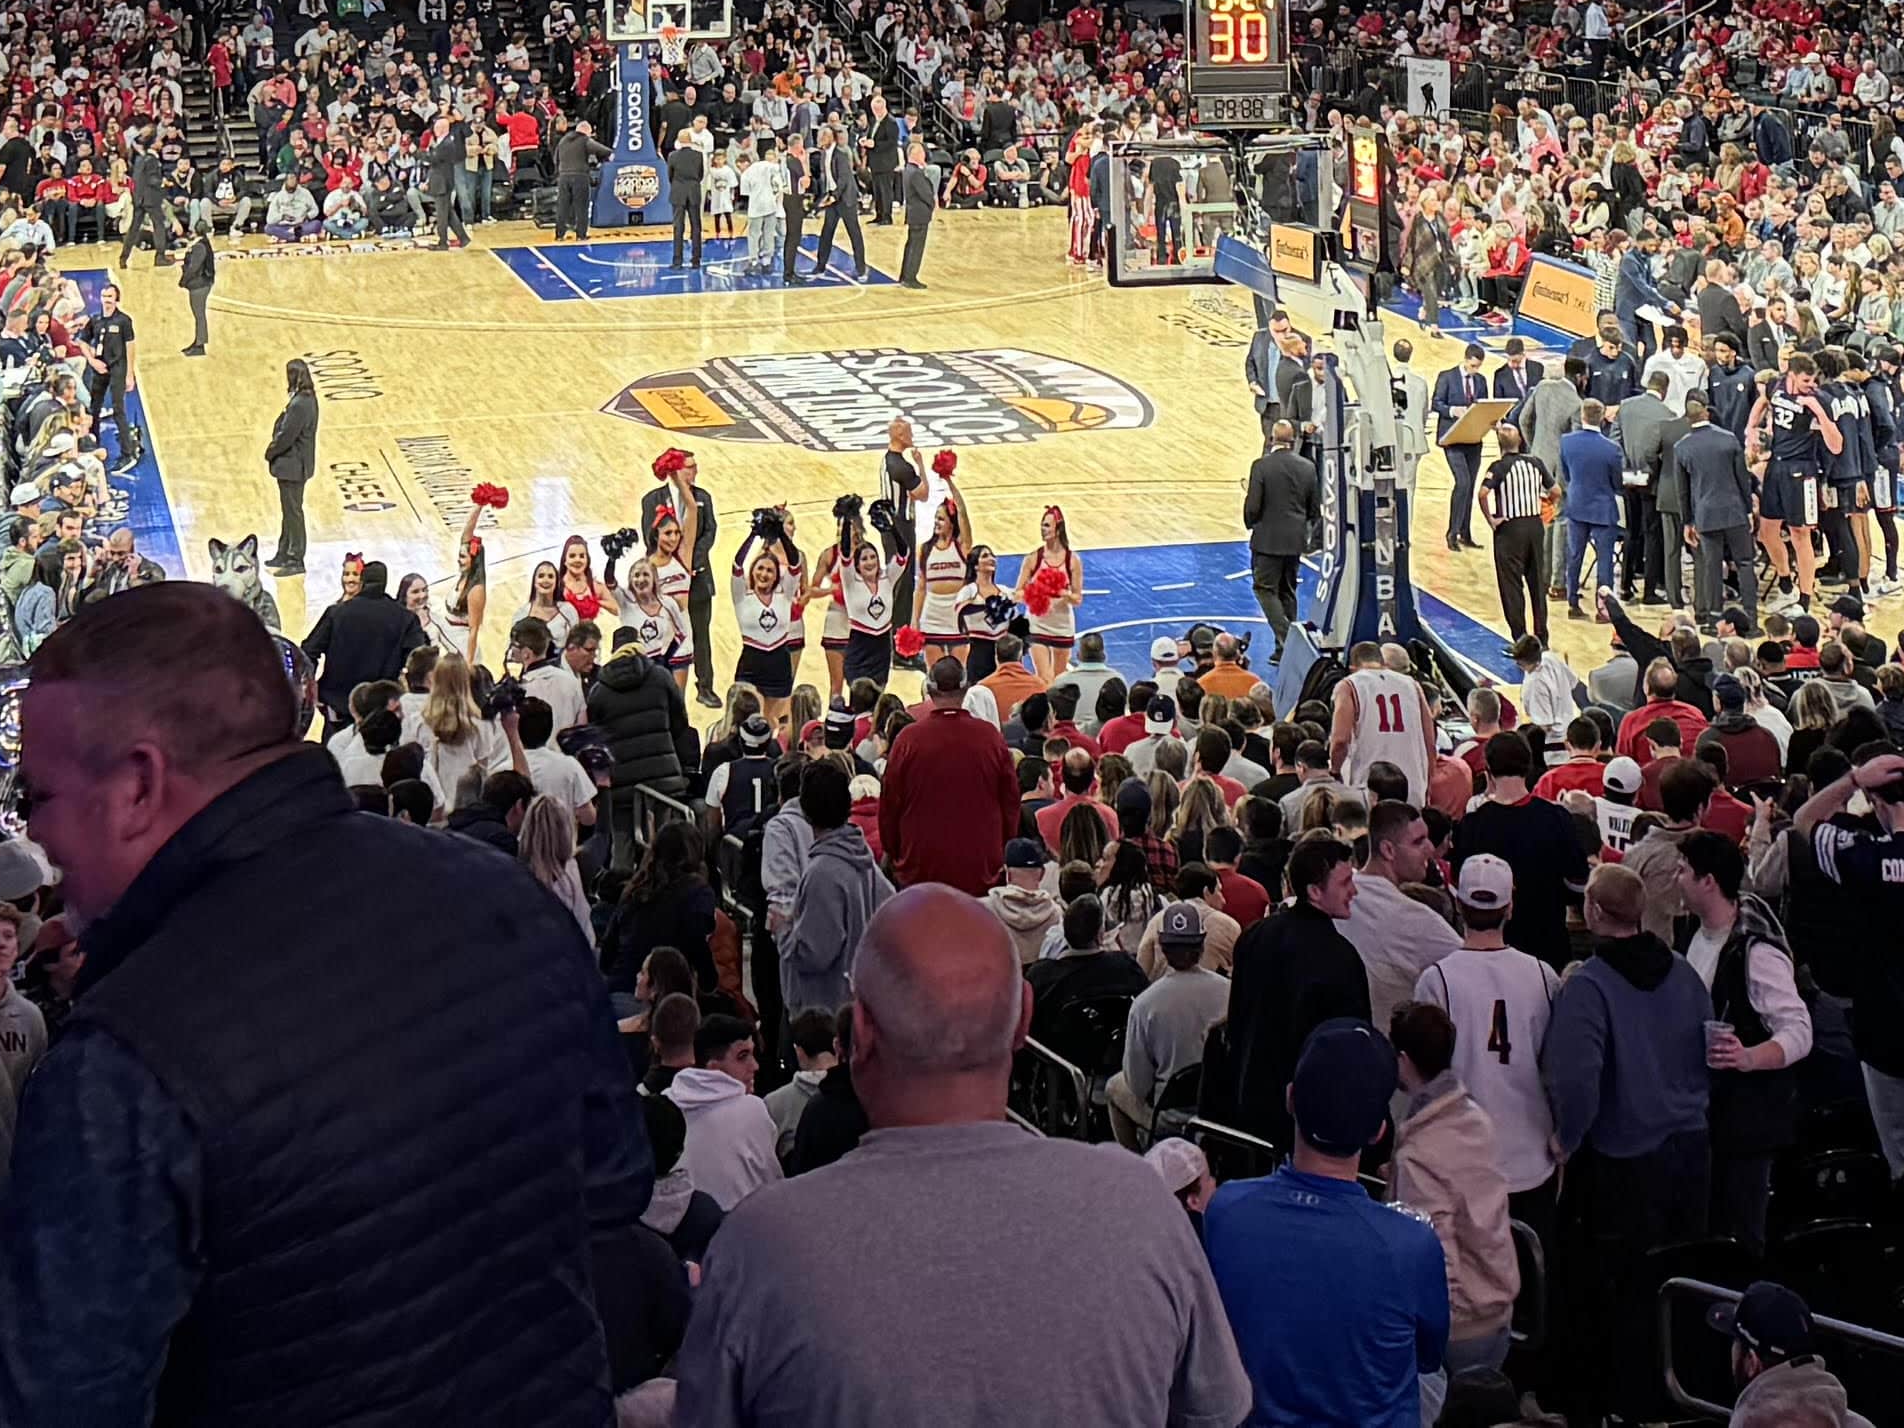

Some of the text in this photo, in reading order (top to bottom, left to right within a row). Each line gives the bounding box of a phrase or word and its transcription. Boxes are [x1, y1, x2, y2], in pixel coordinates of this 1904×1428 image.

[1210, 12, 1268, 63] 30
[627, 82, 645, 151] saatva
[1773, 406, 1795, 431] 32
[1376, 693, 1405, 733] 11
[1487, 999, 1512, 1065] 4
